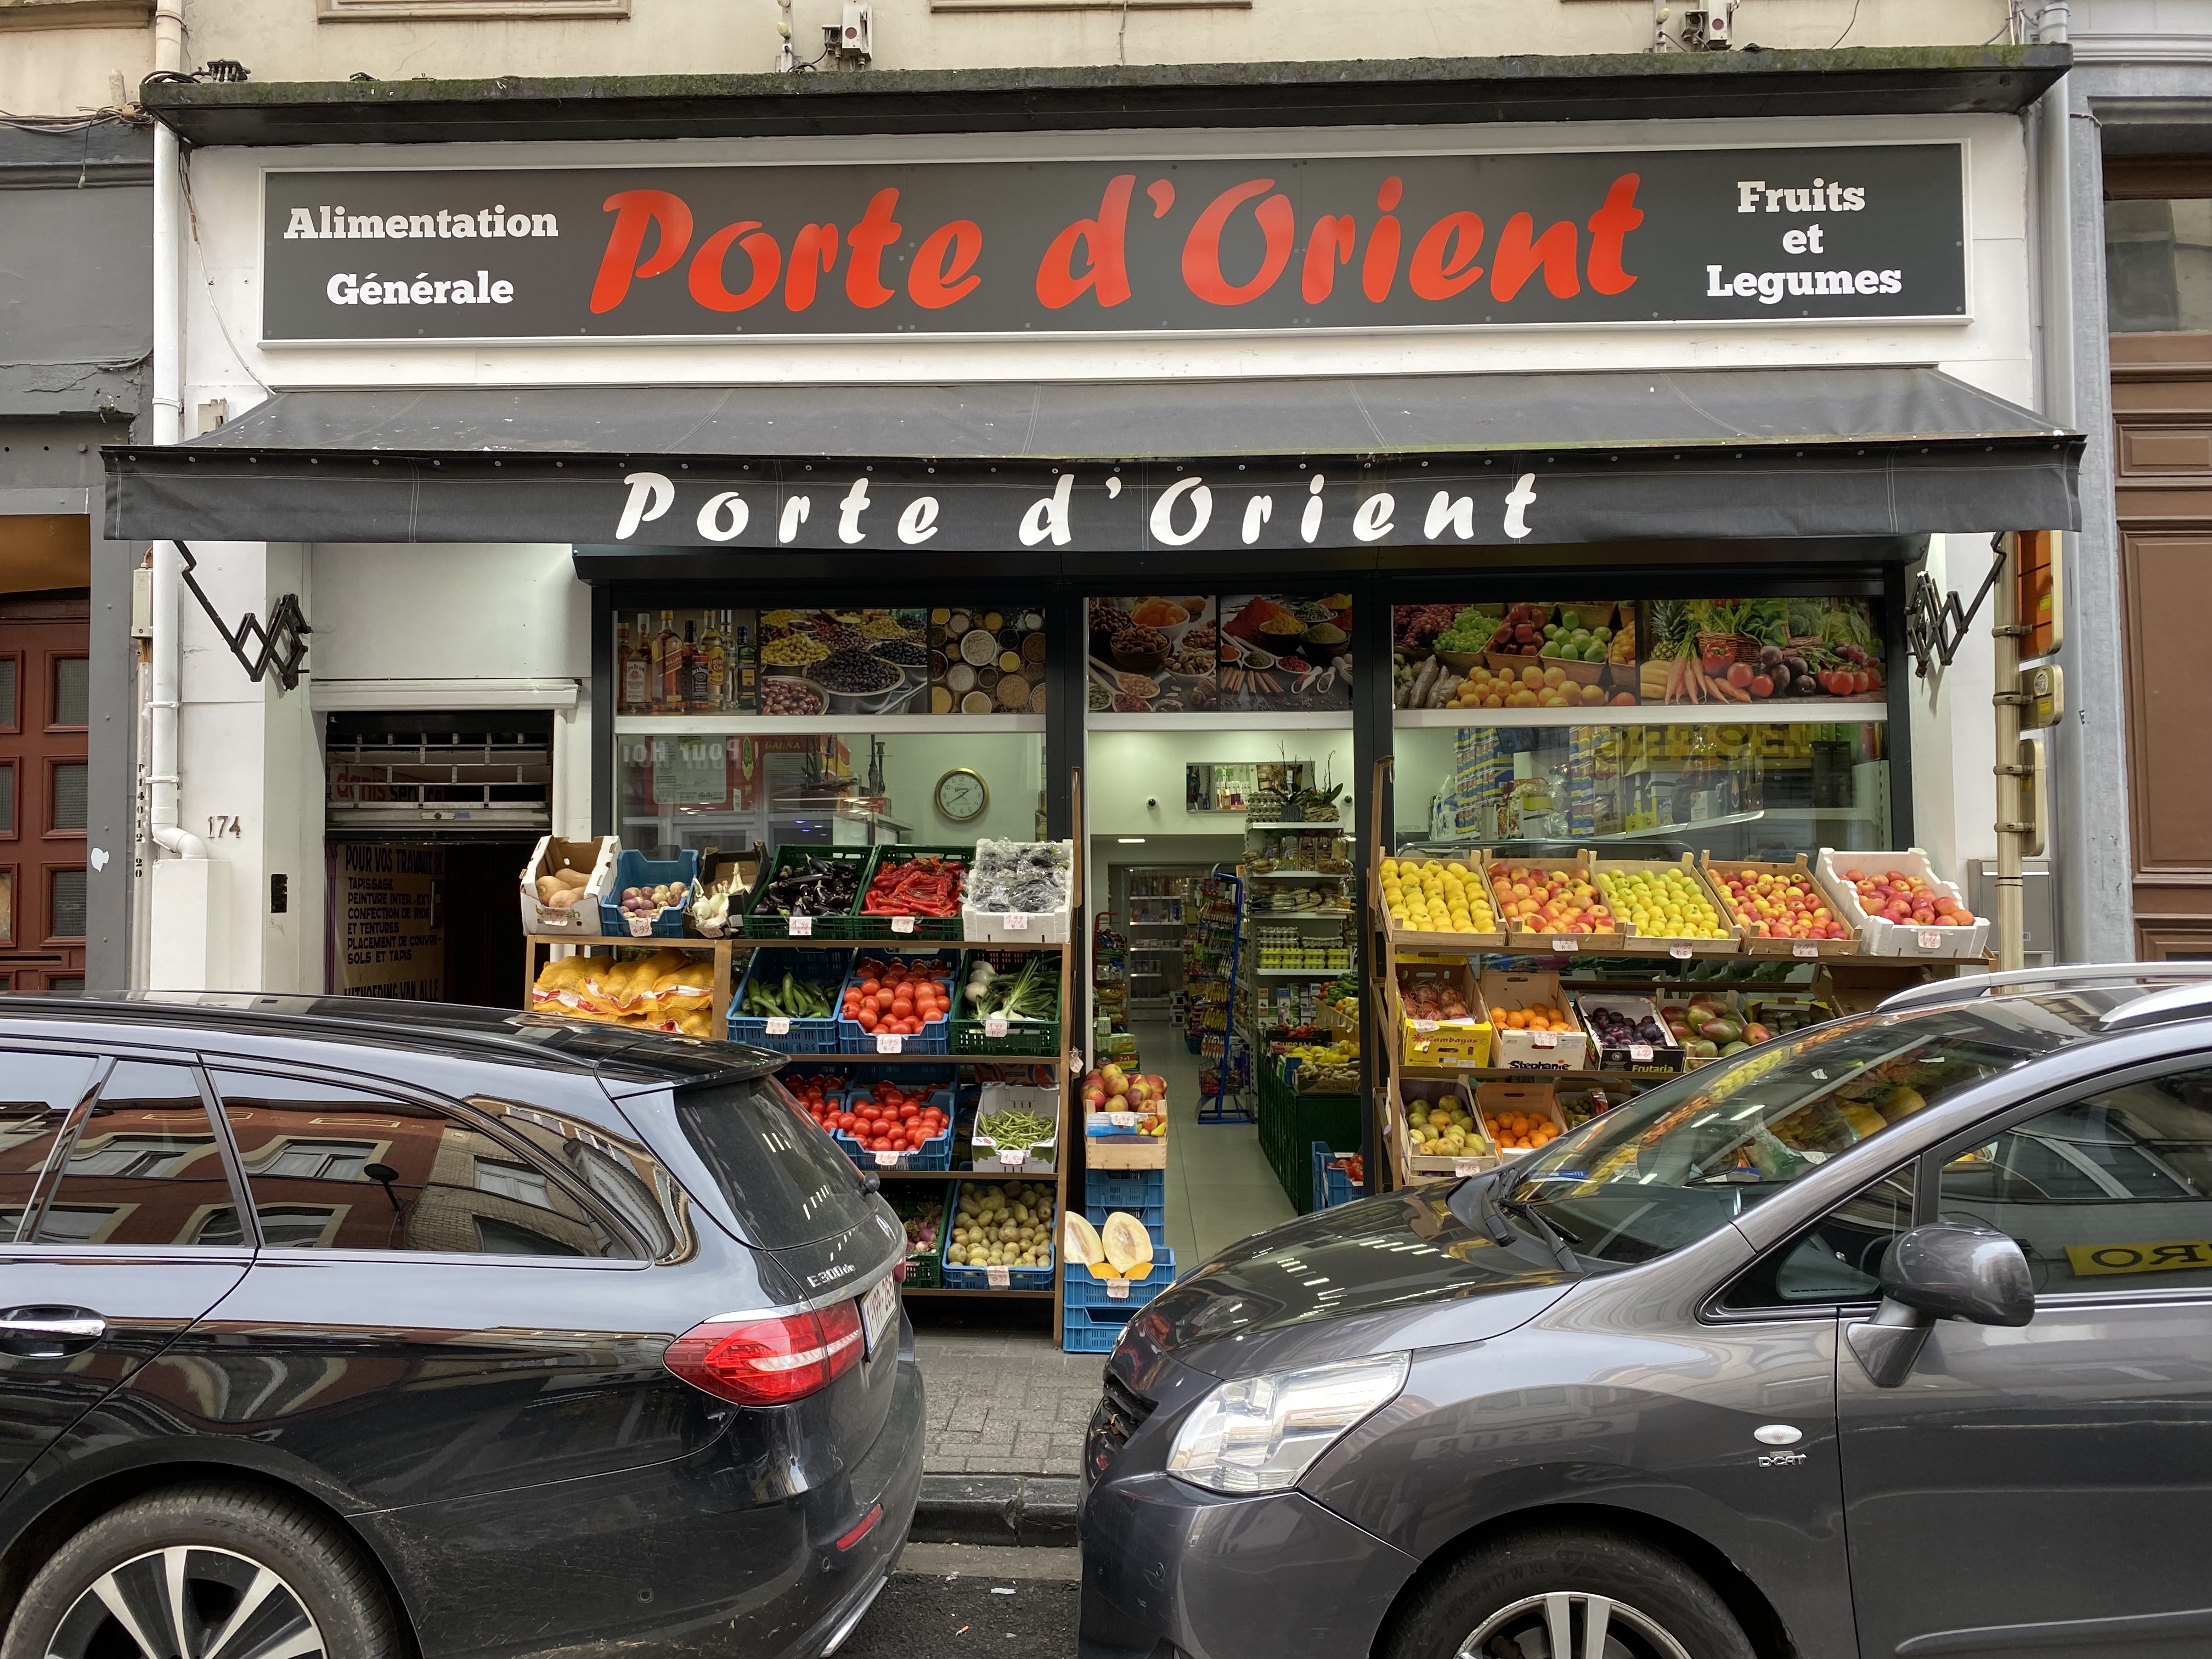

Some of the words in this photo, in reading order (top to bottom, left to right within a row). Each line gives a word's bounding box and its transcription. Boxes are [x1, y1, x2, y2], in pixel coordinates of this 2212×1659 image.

[1737, 178, 1865, 213] Fruits
[284, 204, 558, 239] Alimentation
[590, 188, 982, 314] Porte
[1036, 173, 1644, 310] d'Orient
[1782, 224, 1824, 254] et
[326, 270, 514, 306] Générale
[1706, 265, 1903, 304] Legumes
[616, 472, 939, 545] Porte
[1019, 473, 1537, 546] d'Orient
[207, 815, 240, 839] 174
[346, 844, 372, 872] POUR
[375, 847, 393, 872] VOS
[396, 848, 433, 875] TRAVAUX
[348, 877, 393, 890] TAPISSAGE
[348, 892, 387, 905] PEINTURE
[348, 907, 399, 919] CONFECTION
[402, 908, 411, 919] DE
[348, 923, 357, 935] ET
[360, 922, 399, 934] TENTURES
[348, 936, 396, 950] PLACEMENT
[398, 935, 407, 947] DE
[348, 951, 371, 965] SOLS
[376, 951, 386, 963] ET
[389, 949, 412, 962] TAPIS
[1632, 1064, 1674, 1073] Frutaria
[1758, 1453, 1808, 1468] D-CAT
